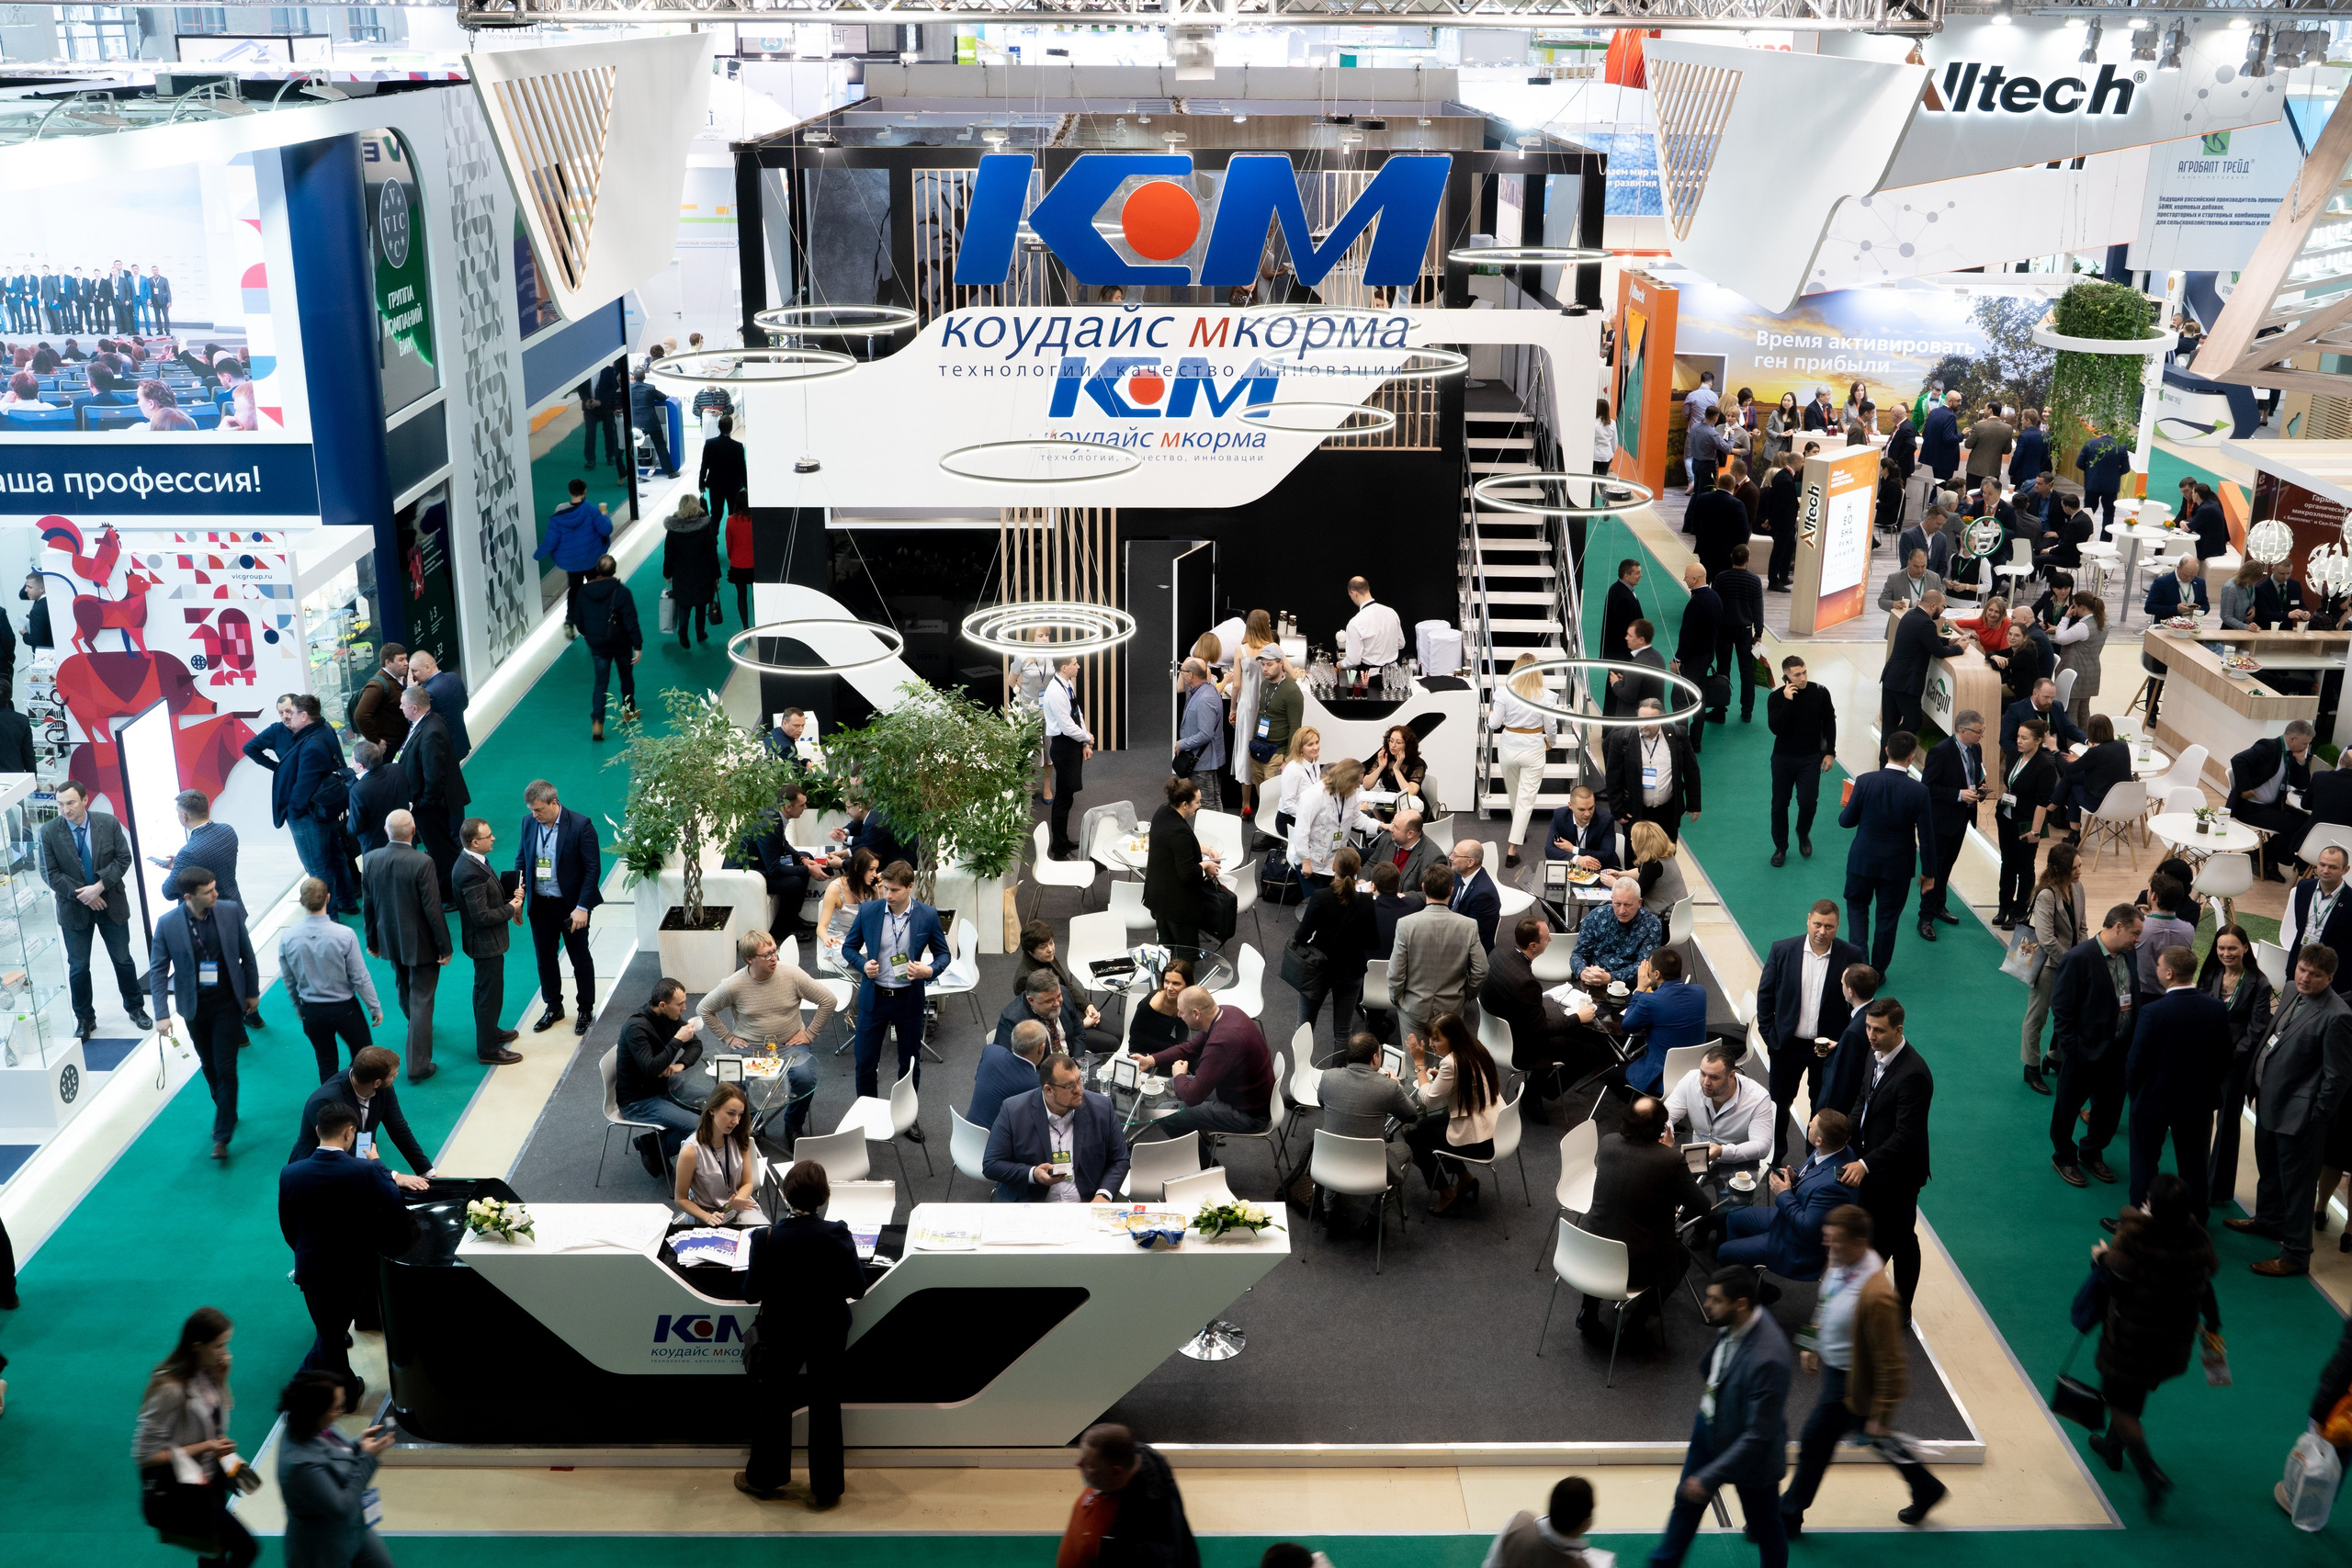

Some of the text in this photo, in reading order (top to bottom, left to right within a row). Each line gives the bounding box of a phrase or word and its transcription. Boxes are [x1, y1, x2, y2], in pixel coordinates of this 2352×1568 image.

[1630, 168, 1648, 177] мир
[1614, 180, 1657, 188] развития
[383, 211, 406, 234] VIC
[388, 284, 415, 310] ГРУППА
[383, 302, 424, 338] КОМПАНИЙ
[941, 303, 1410, 361] коудайс мкорма
[1756, 330, 1977, 356] Время активировать
[398, 335, 413, 357] ВИК
[939, 365, 1102, 380] технологии,
[1259, 364, 1402, 380] инновации
[1754, 355, 1890, 374] ген прибыли
[1160, 432, 1267, 453] мкорма
[1193, 454, 1264, 462] инновации
[63, 466, 261, 500] профессия!
[1800, 483, 1820, 549] Alltech
[1926, 678, 1951, 715] Cargill
[650, 1347, 710, 1359] коудайс
